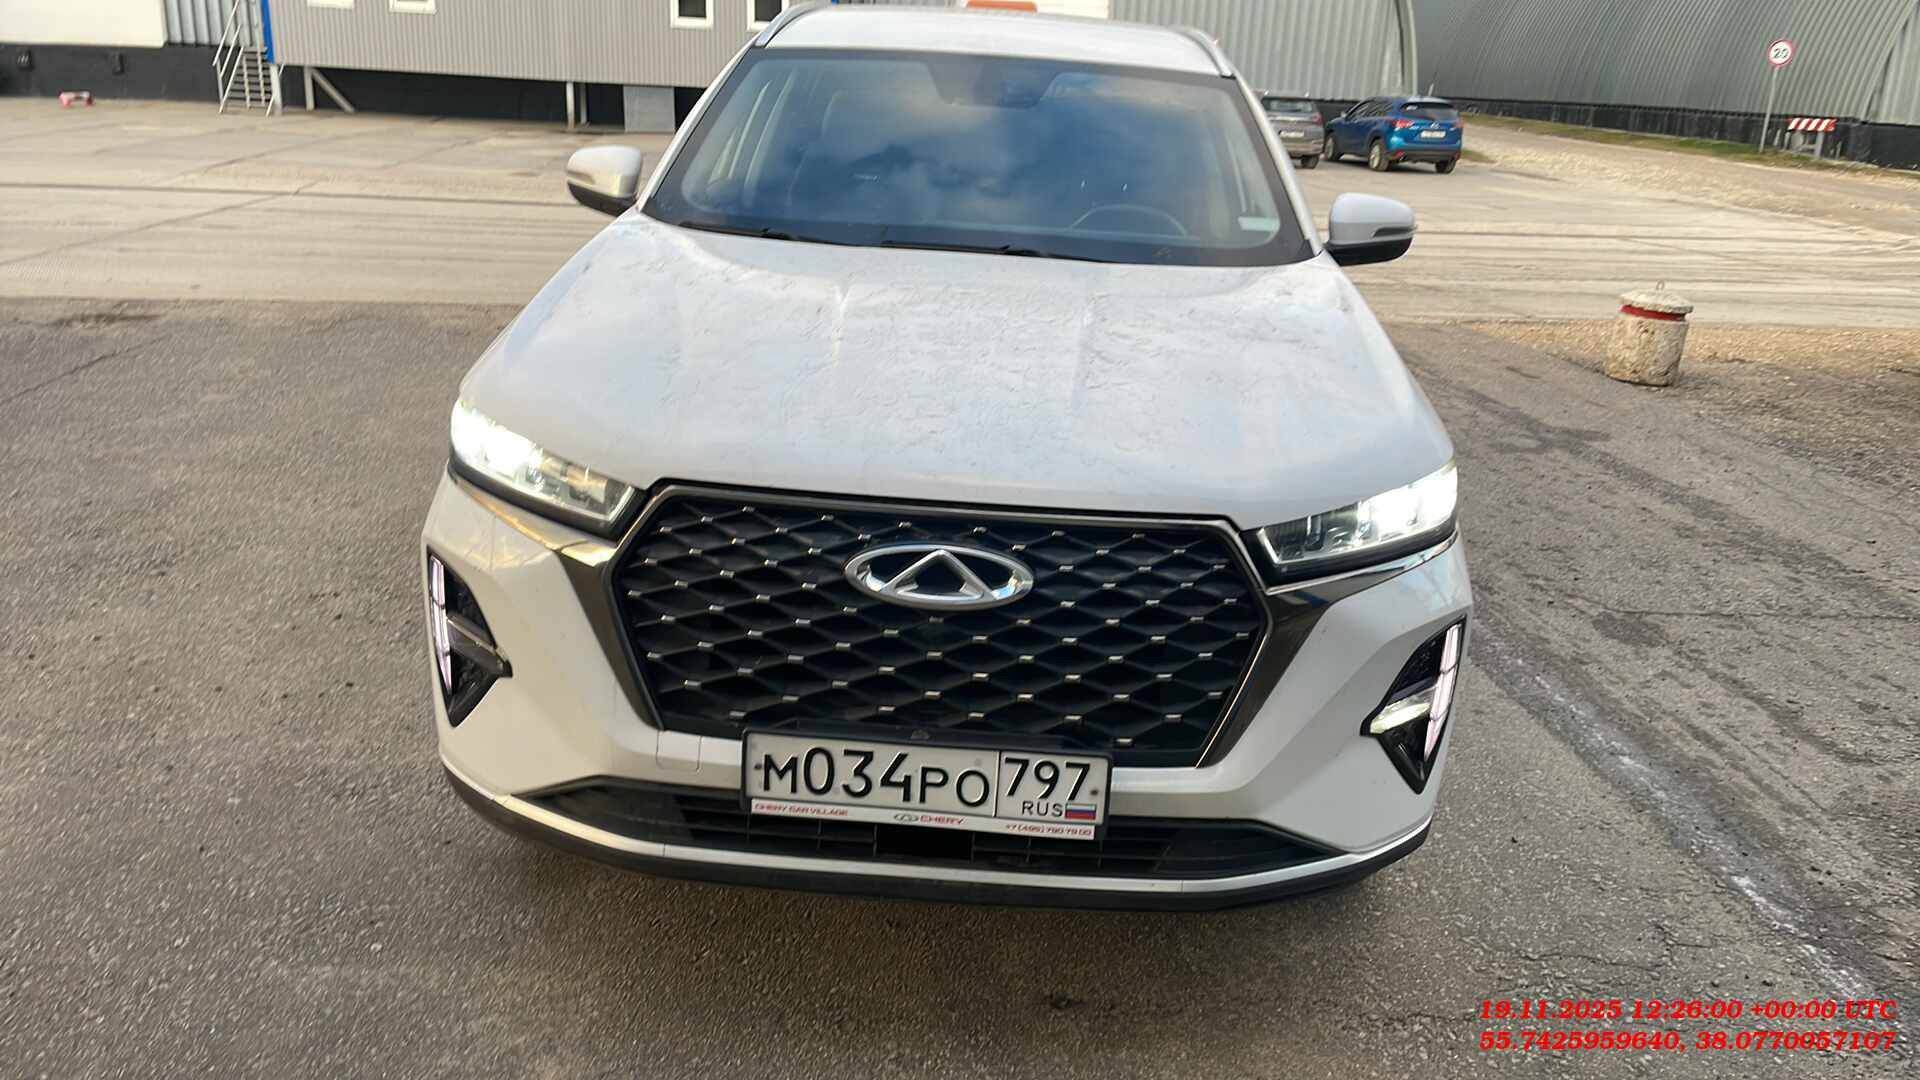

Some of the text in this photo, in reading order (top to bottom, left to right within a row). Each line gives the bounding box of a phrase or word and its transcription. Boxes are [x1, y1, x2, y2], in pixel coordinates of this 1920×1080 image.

[1003, 757, 1092, 801] 797
[1021, 800, 1064, 818] RUS
[920, 815, 965, 825] CHERY
